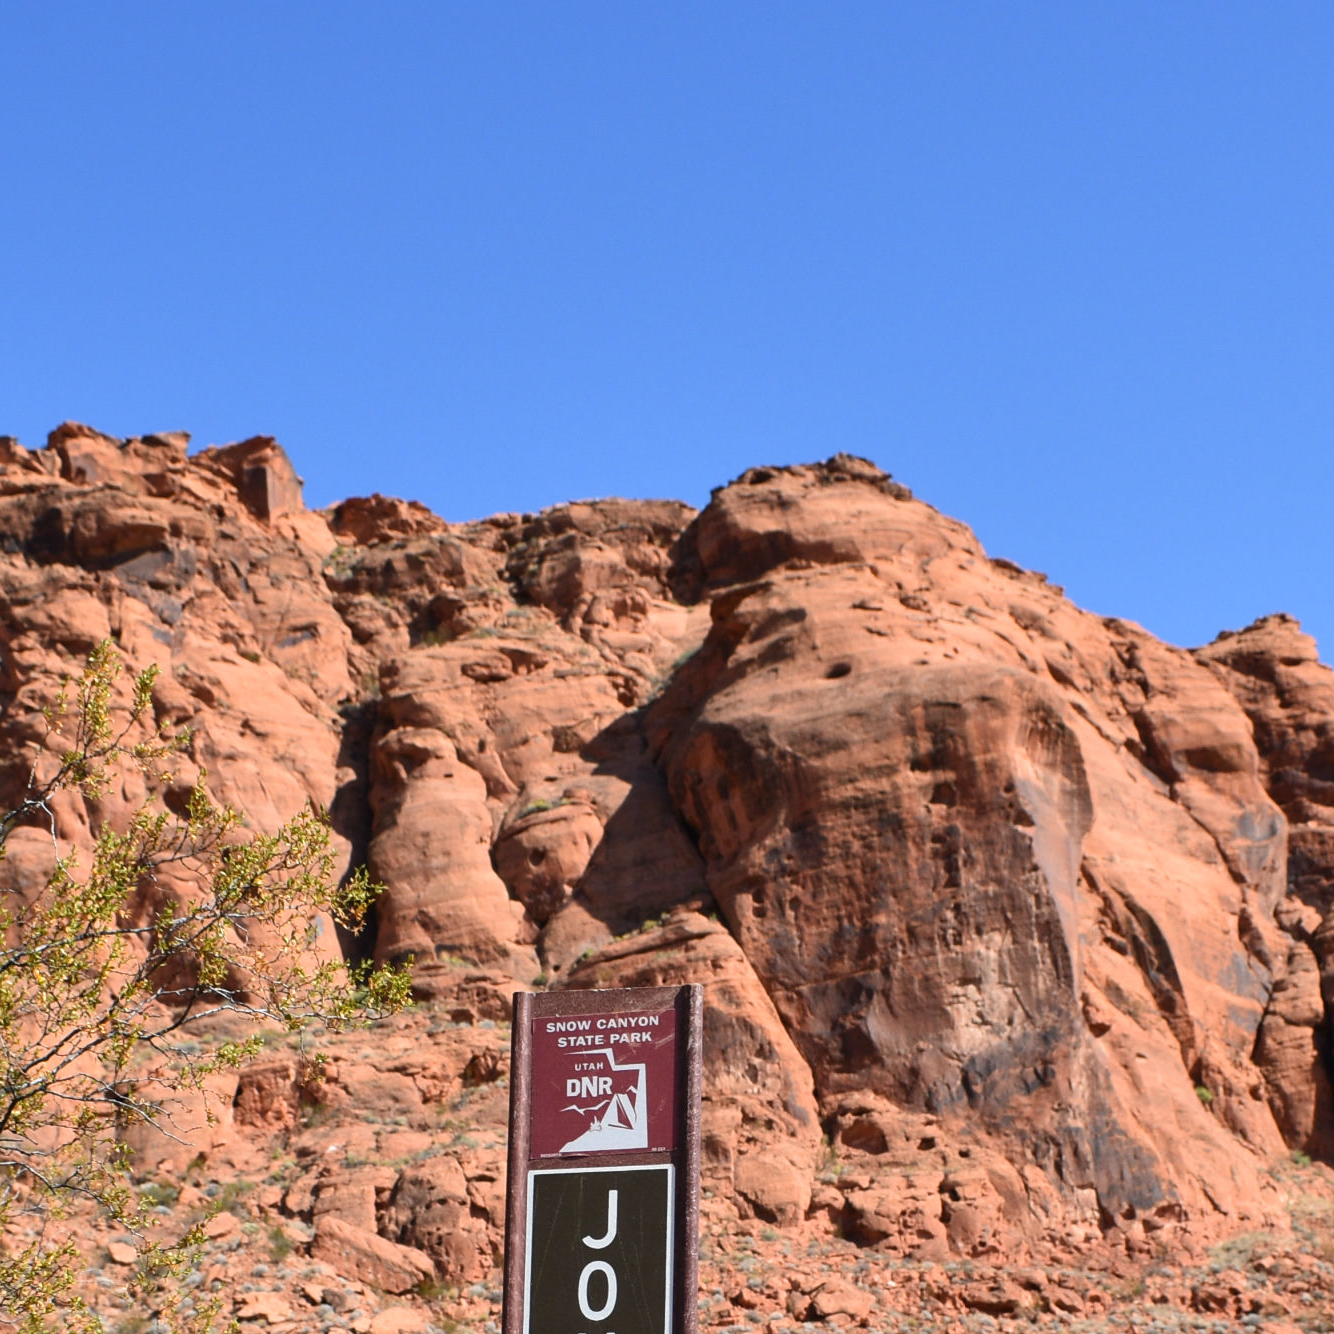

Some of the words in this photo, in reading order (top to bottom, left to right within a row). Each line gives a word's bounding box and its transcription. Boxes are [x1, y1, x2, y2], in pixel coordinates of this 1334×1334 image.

[546, 1020, 591, 1033] SNOW
[596, 1016, 659, 1029] CANYON
[557, 1035, 604, 1047] STATE
[610, 1032, 652, 1044] PARK
[575, 1062, 603, 1071] UTAH
[566, 1076, 612, 1097] DNR
